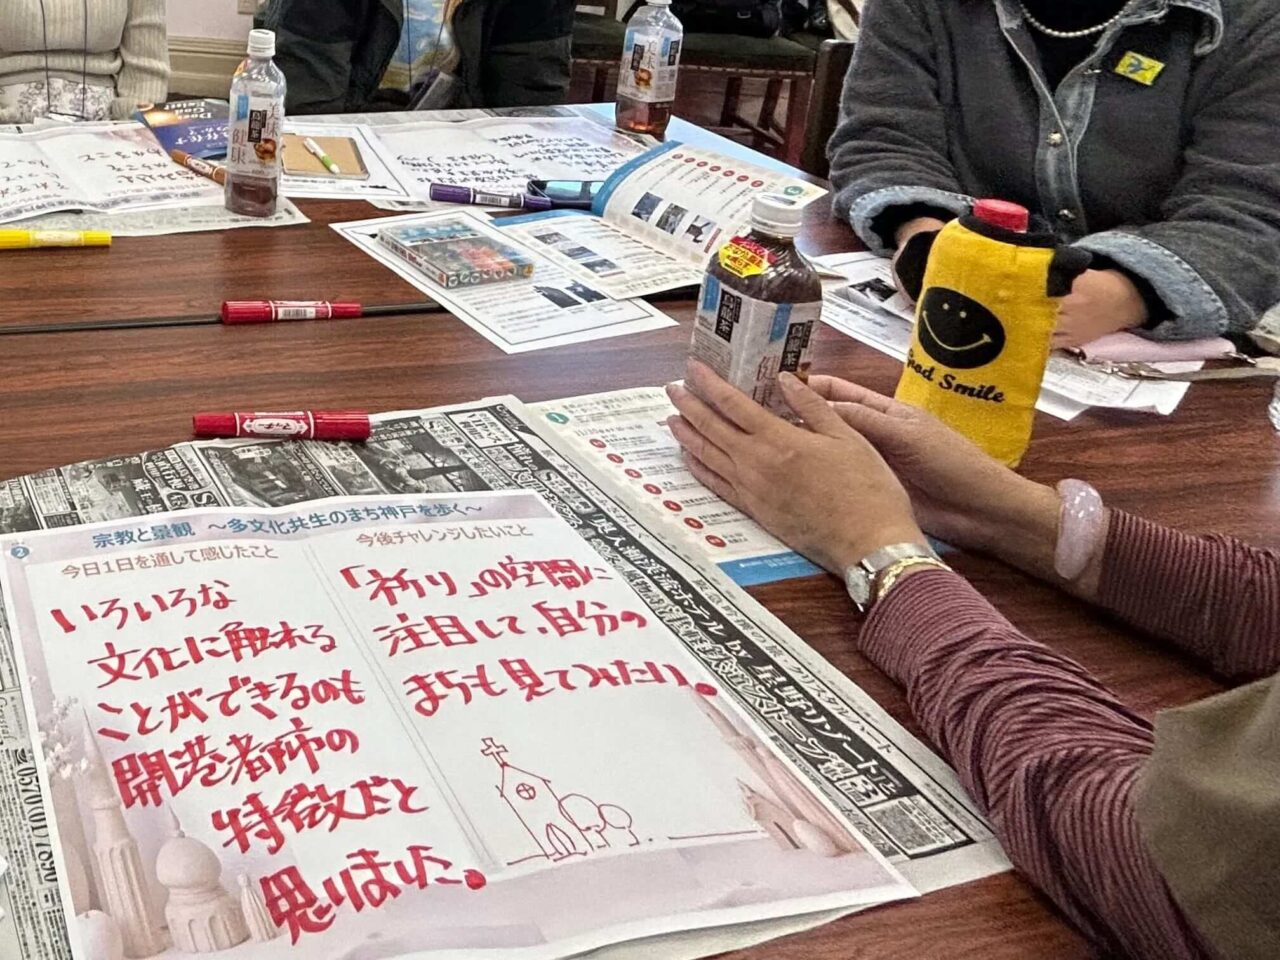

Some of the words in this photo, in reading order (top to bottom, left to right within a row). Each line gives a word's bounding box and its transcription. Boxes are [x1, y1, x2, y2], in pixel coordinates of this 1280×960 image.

[939, 374, 1004, 403] Smile
[61, 543, 278, 580] 今日1日を通して感じたこと
[93, 521, 196, 549] 宗教と景観
[356, 523, 535, 548] 今後チャレンジしたいこと
[50, 578, 238, 634] いろいろな
[340, 554, 616, 607] 「祈り」の空間に
[87, 620, 340, 690] 文化に触れる
[376, 601, 649, 657] 注目して、自分の
[725, 639, 754, 660] by
[97, 667, 368, 742] ことができるのも
[211, 775, 429, 856] 特徴だと
[259, 845, 488, 947] 思いました。
